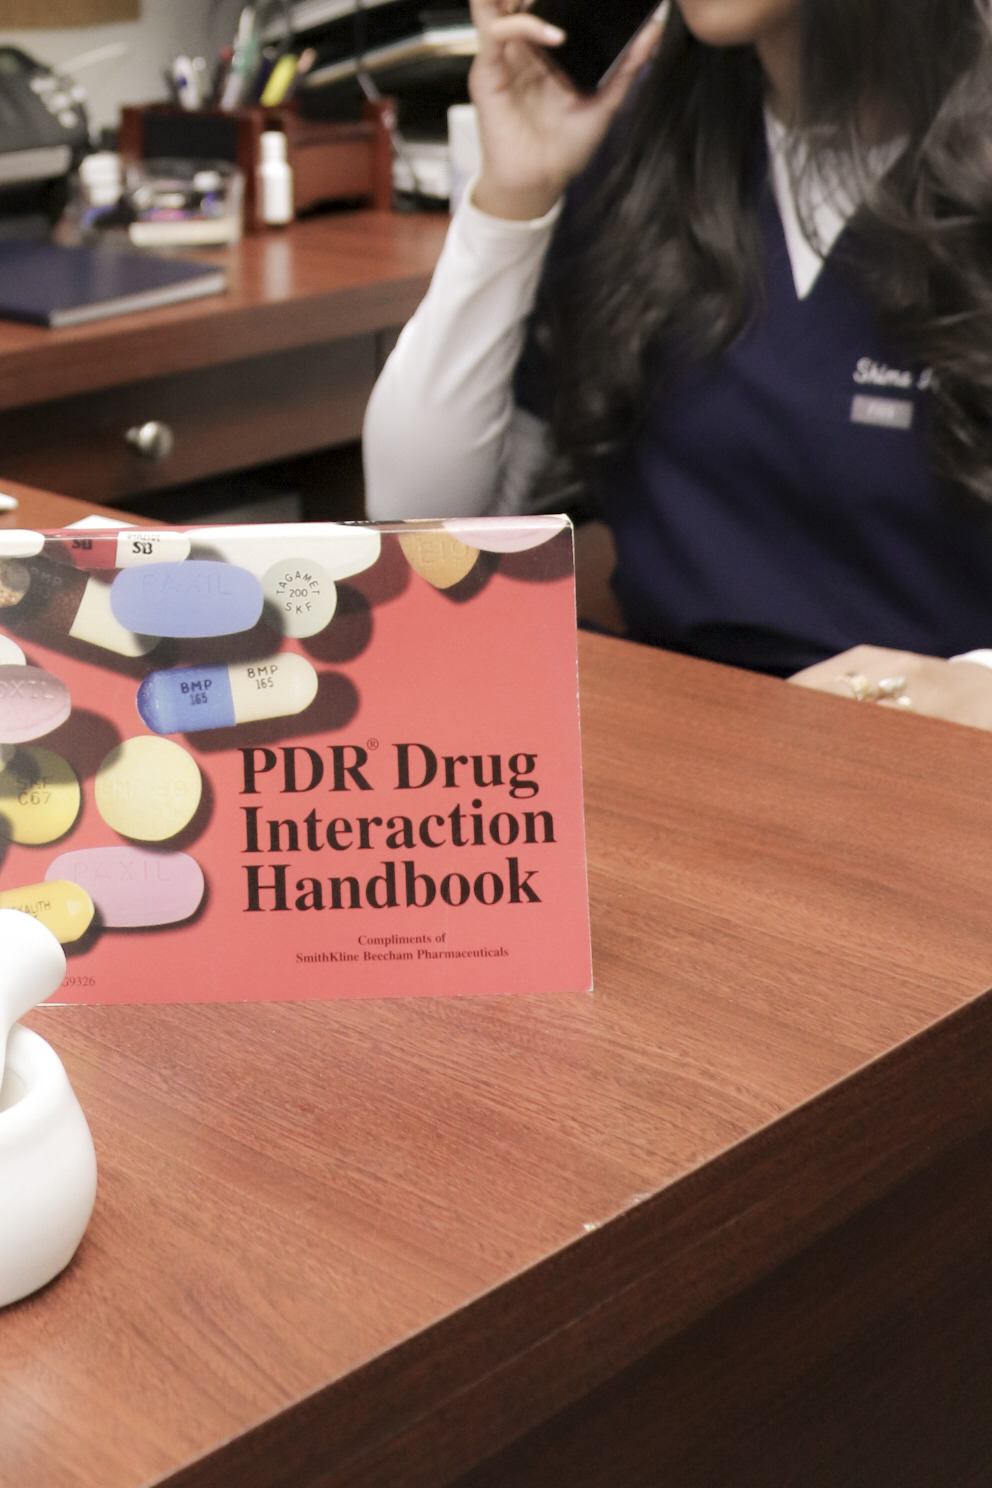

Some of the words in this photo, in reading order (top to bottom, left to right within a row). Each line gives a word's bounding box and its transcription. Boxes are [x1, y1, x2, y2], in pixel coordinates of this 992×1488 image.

[132, 540, 154, 555] SB
[276, 571, 320, 595] TAGAMET
[289, 589, 308, 598] 200
[247, 665, 278, 678] BMP
[180, 679, 212, 694] BMP
[256, 677, 274, 689] 165
[190, 693, 208, 705] 165
[392, 742, 540, 799] Drug
[17, 791, 52, 806] C67
[239, 798, 558, 854] Interaction
[74, 860, 174, 882] PAXIL
[242, 856, 543, 913] Handbook
[358, 934, 432, 948] Compliments
[435, 932, 447, 943] of
[295, 951, 360, 963] SmithKline
[363, 948, 414, 962] Beecham
[417, 946, 510, 961] Pharmaceuticals
